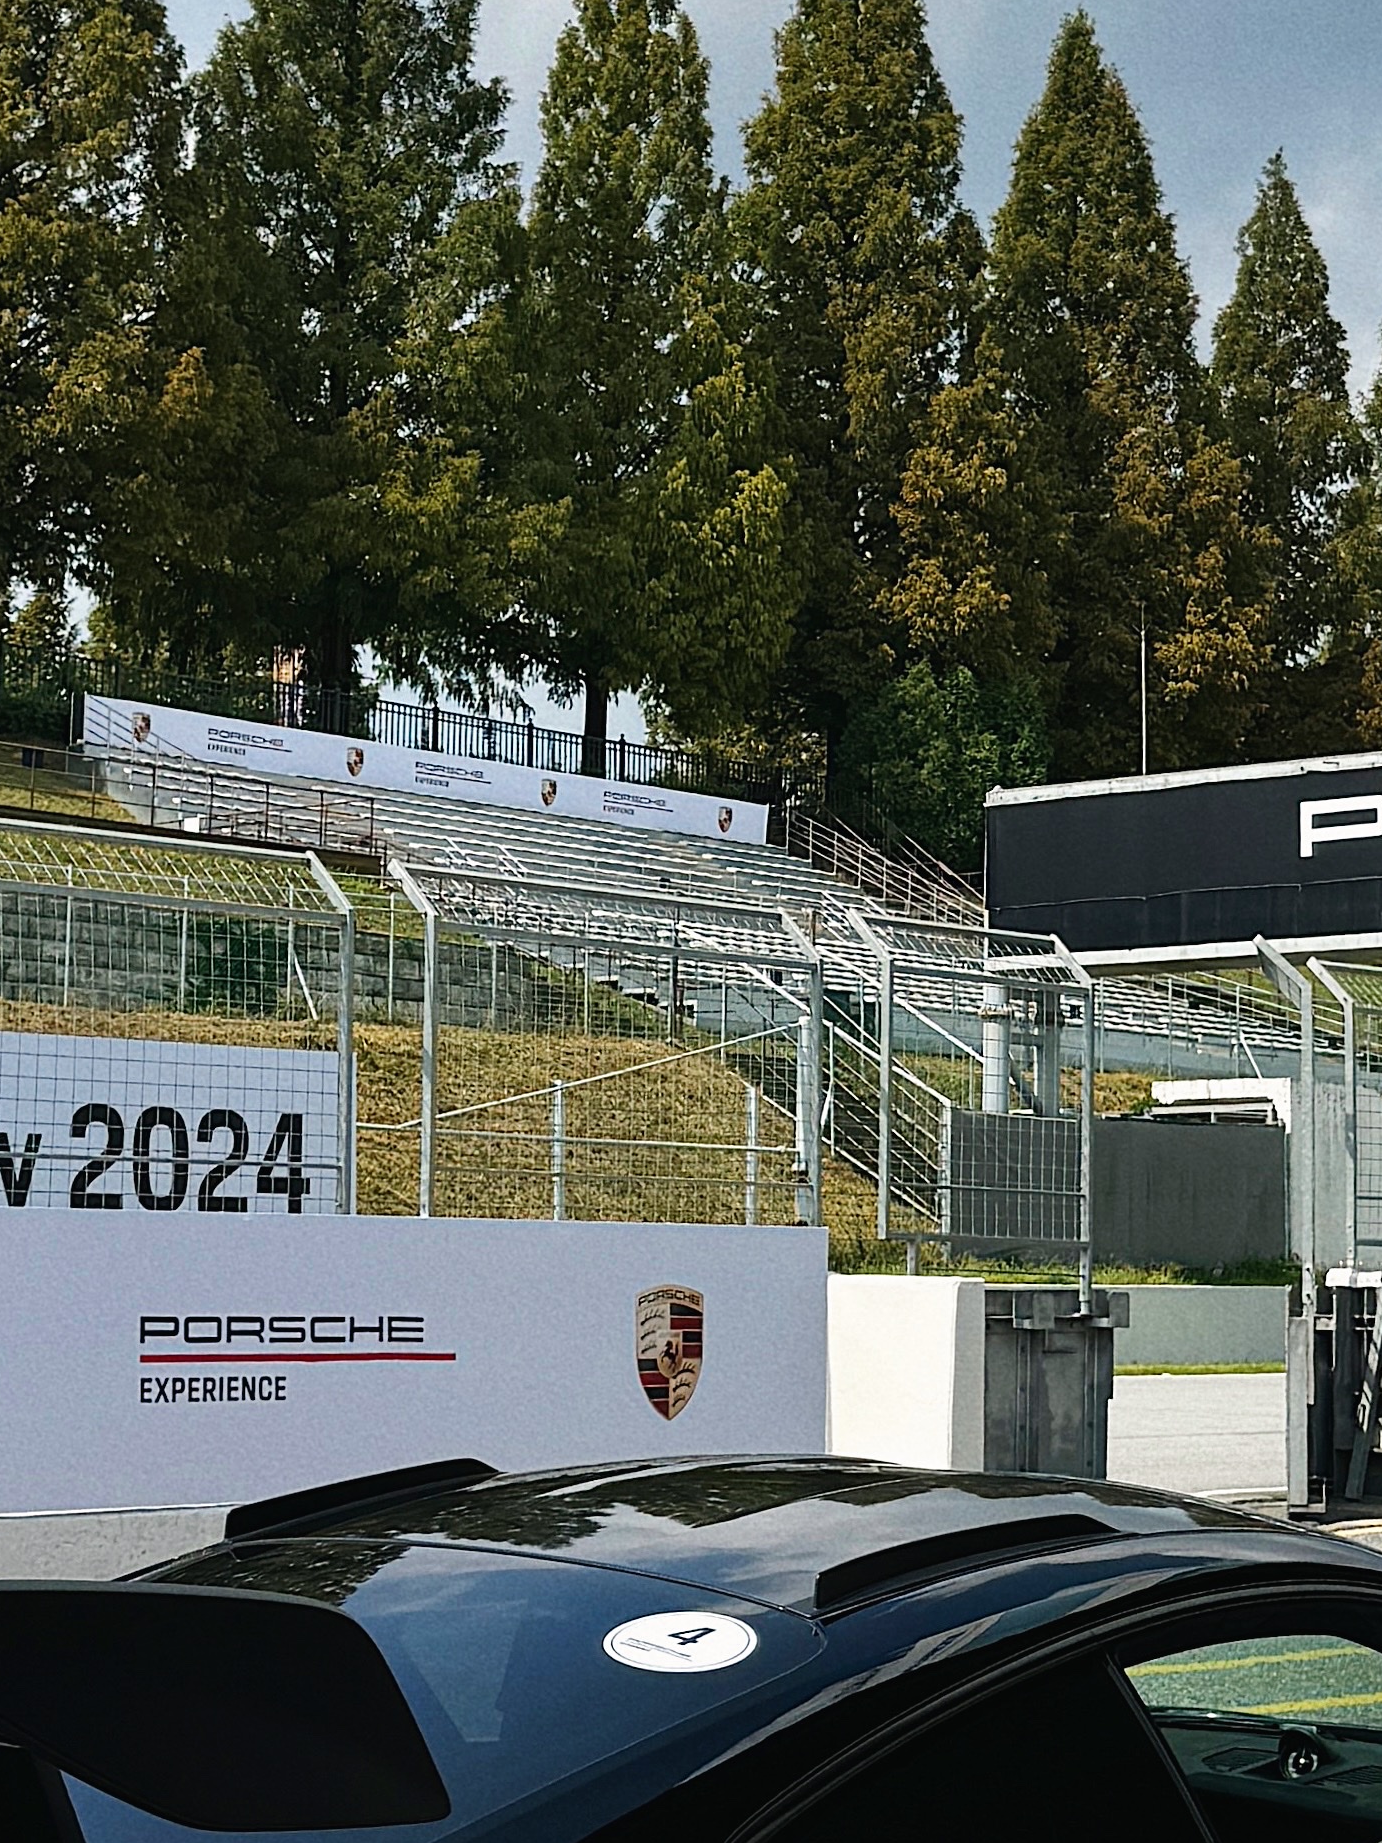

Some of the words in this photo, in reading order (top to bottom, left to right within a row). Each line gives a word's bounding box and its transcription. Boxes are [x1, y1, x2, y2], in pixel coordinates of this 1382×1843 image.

[69, 1103, 311, 1214] 2024
[139, 1315, 425, 1344] PORSCHE
[140, 1375, 287, 1404] EXPERIENCE
[667, 1627, 716, 1646] 4
